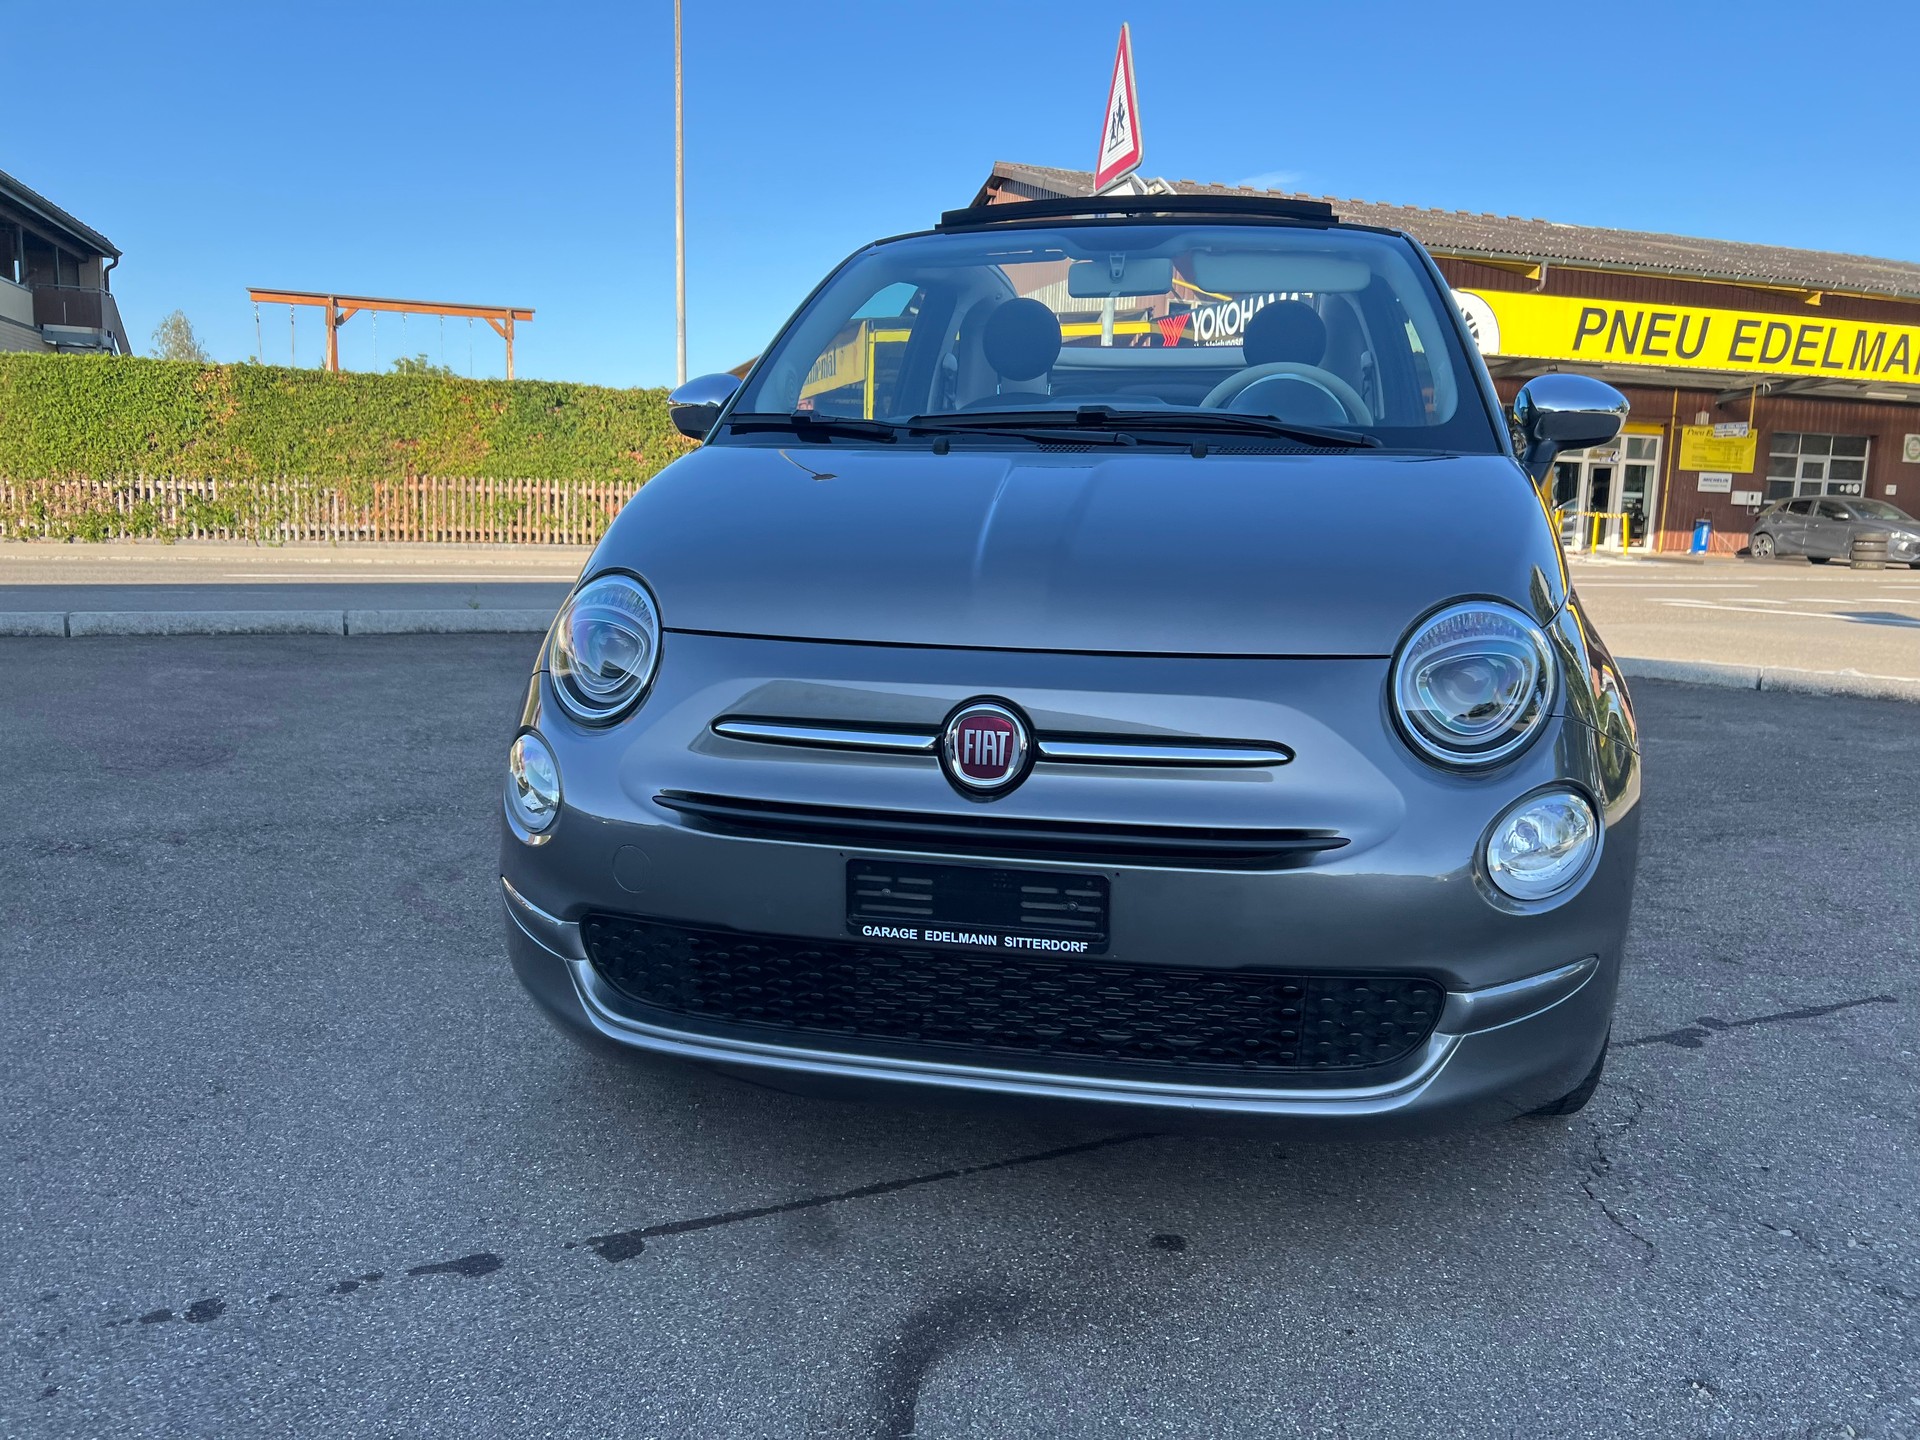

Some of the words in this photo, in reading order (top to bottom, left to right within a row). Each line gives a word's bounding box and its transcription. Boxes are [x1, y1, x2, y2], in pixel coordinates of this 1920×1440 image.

[1191, 292, 1299, 342] YOKOH
[1572, 307, 1712, 359] PNEU
[1727, 319, 1920, 376] EDELMA
[963, 729, 1010, 767] FIAT
[862, 925, 918, 940] GARAGE
[924, 930, 997, 946] EDELMANN
[1004, 936, 1088, 953] SITTERDORF
